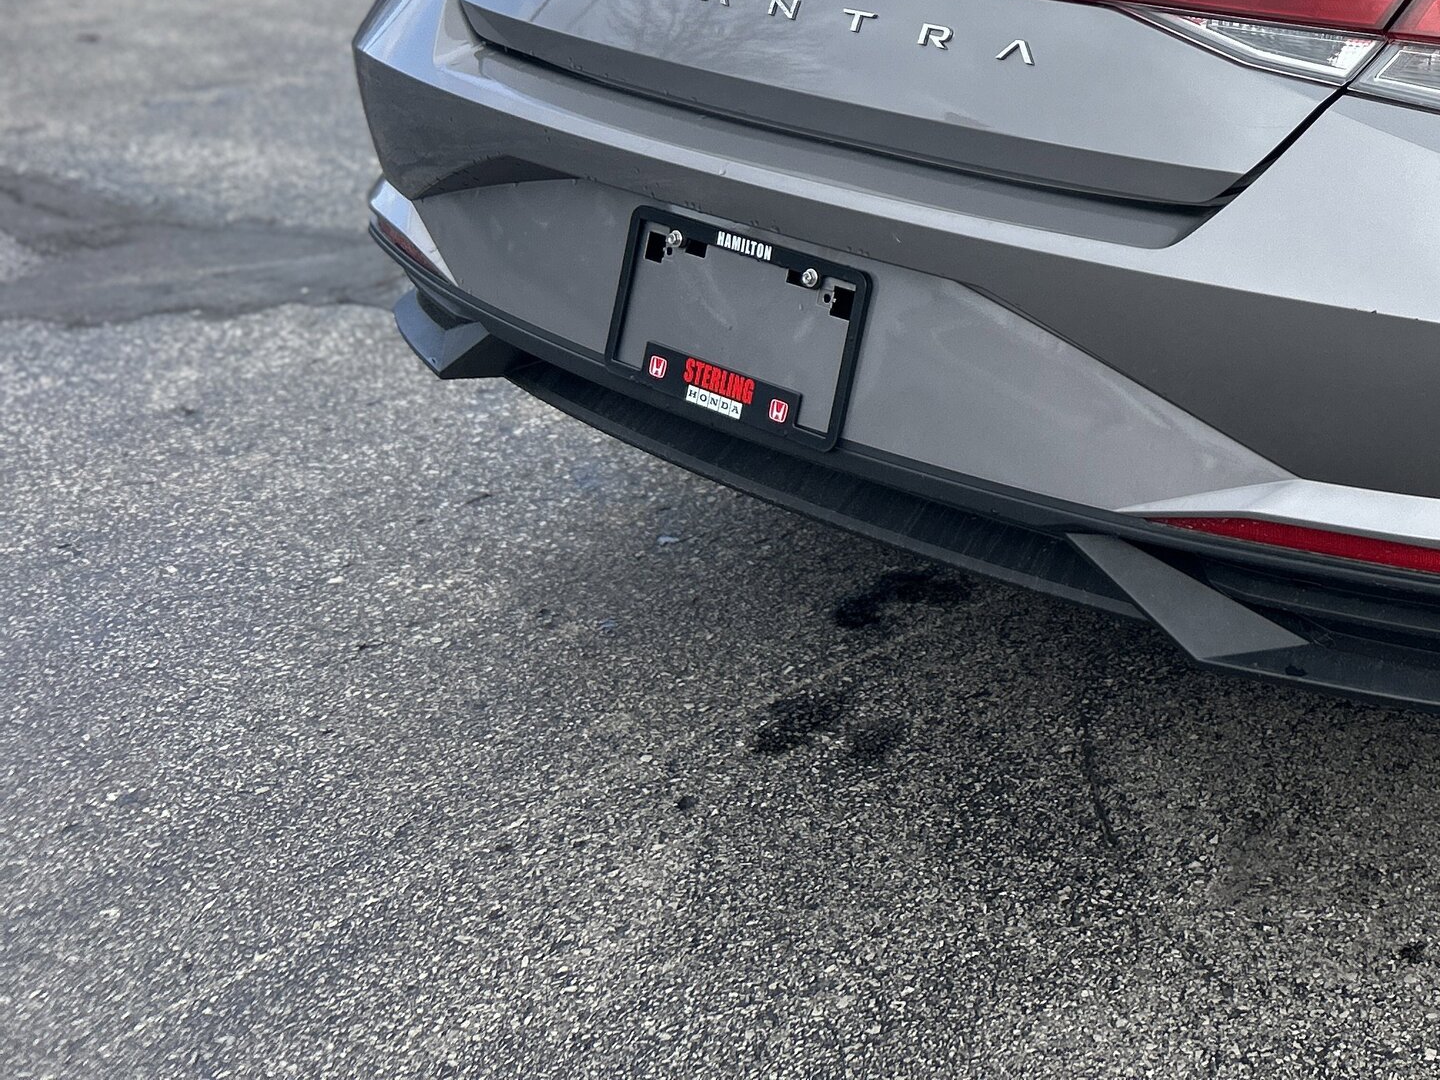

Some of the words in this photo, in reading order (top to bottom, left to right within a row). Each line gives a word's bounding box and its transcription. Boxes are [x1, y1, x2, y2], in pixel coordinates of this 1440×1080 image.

[716, 230, 773, 261] HAMILTON
[683, 357, 756, 405] STERLING
[687, 388, 740, 416] HONDA
